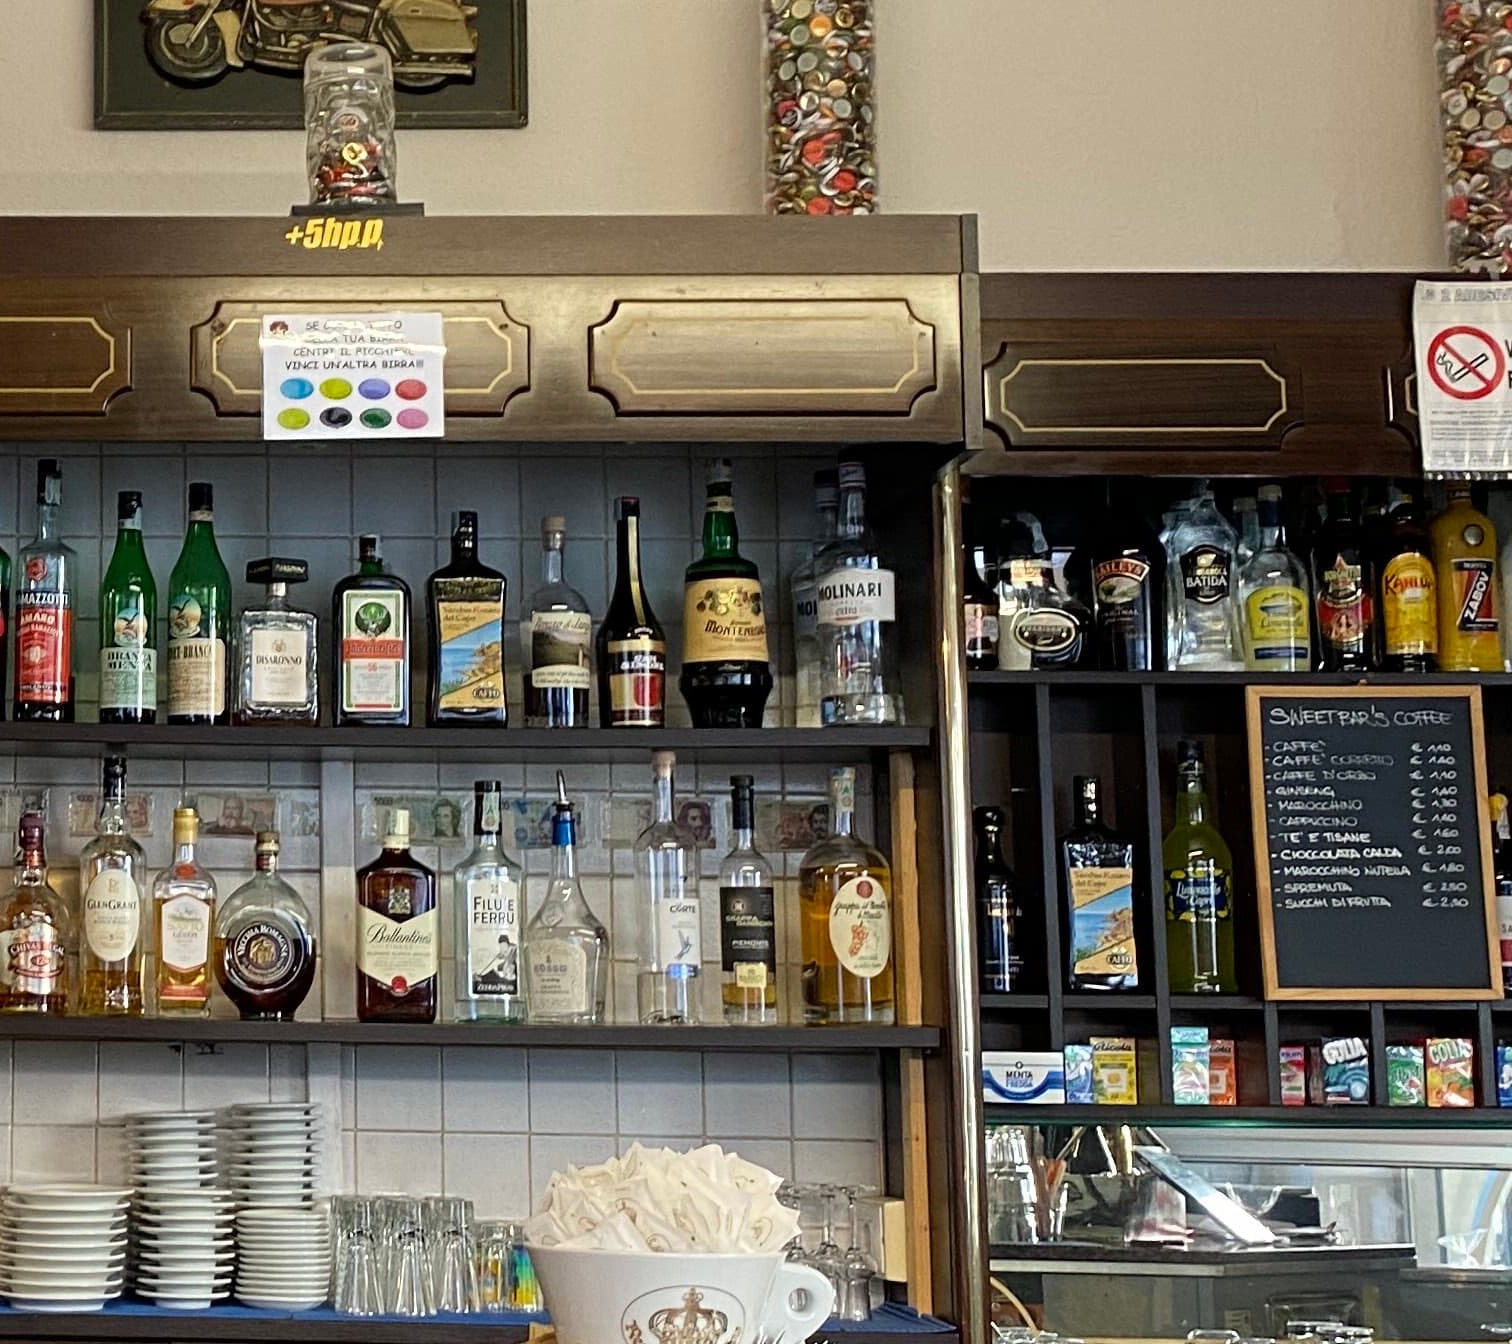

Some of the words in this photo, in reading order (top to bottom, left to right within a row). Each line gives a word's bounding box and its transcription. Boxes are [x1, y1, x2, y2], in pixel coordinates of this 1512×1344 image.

[343, 335, 365, 343] TUA
[285, 360, 319, 370] VINCI
[1186, 576, 1228, 588] BATIDA
[818, 582, 882, 599] MOLINARI
[1463, 572, 1490, 620] ZABOV
[255, 655, 302, 666] DISARONNO
[1393, 710, 1454, 726] COFFEE
[1278, 799, 1363, 811] MAROCCHINO
[1278, 816, 1358, 827] CAPPUCCINO
[1323, 831, 1372, 843] TISANE
[1280, 848, 1361, 861] CIOCCOLATA
[1362, 847, 1402, 858] CALDA
[1283, 866, 1361, 877] MAROCCHINO
[1364, 865, 1411, 876] NUTELLA
[1283, 883, 1352, 893] SPREMUTA
[473, 912, 515, 925] FERRU
[1322, 1037, 1368, 1065] GOLIA
[1430, 1039, 1473, 1064] GOLIA
